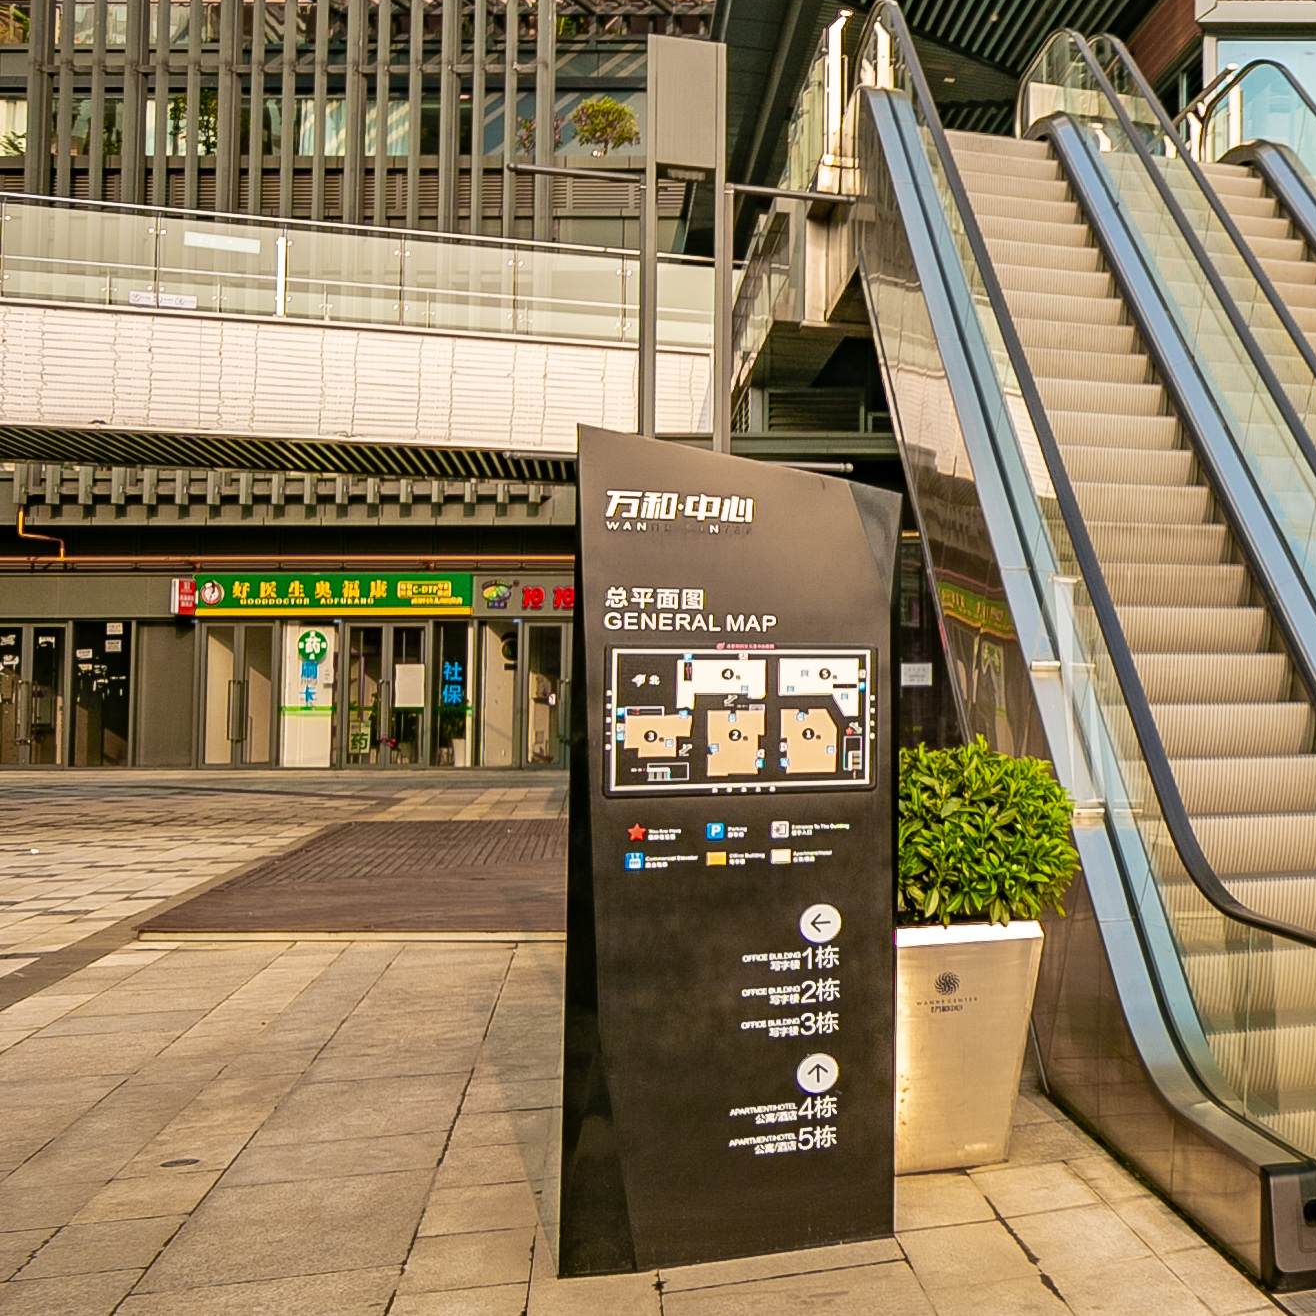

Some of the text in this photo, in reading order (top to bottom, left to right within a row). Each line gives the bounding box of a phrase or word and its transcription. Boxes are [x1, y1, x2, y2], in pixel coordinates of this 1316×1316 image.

[605, 586, 705, 610] 总平面图
[603, 612, 778, 633] GENERAL MAP
[304, 637, 321, 655] 药
[442, 661, 463, 705] 社保
[802, 945, 840, 970] 1栋
[800, 977, 841, 1004] 2栋
[800, 1010, 840, 1036] 3栋
[798, 1095, 838, 1120] 4栋
[798, 1125, 838, 1151] 5栋
